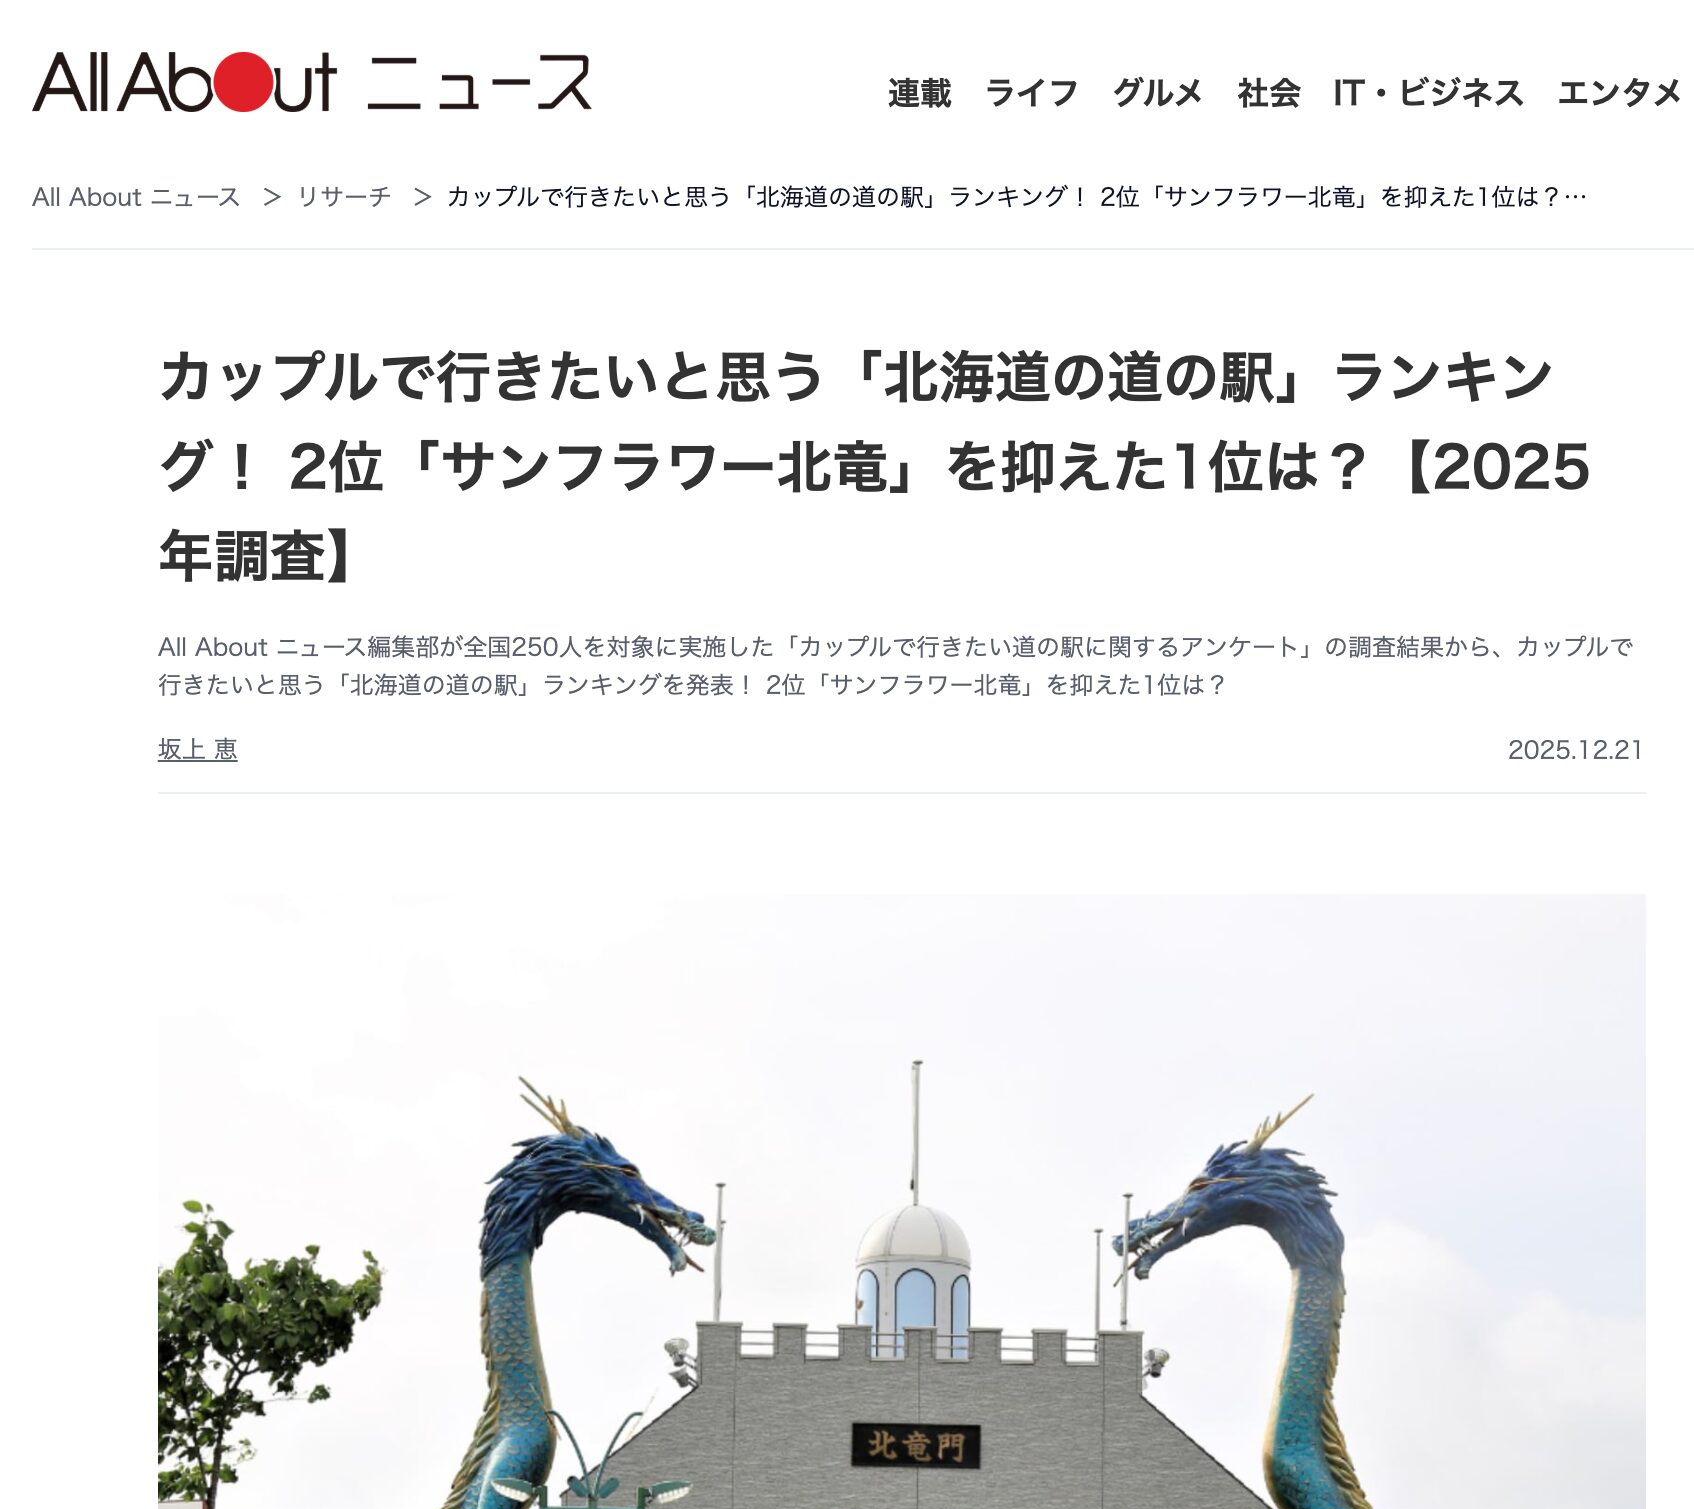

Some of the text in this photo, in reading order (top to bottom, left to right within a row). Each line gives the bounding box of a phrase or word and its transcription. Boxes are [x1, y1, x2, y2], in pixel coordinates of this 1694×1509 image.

[31, 51, 593, 113] All About ニュース
[888, 77, 952, 108] 連載
[986, 77, 1078, 108] ライフ
[1113, 77, 1202, 108] グルメ
[1237, 77, 1302, 108] 社会
[1558, 77, 1681, 108] エンタメ
[31, 184, 240, 209] All About ニュース
[300, 184, 391, 209] リサーチ
[448, 184, 1083, 209] カップルで行きたいと思う「北海道の道の駅」ランキング！
[161, 349, 1552, 404] カップルで行きたいと思う「北海道の道の駅」ランキン
[160, 437, 1590, 495] グ！ 2位「サンフラワー北竜」を抑えた1位は？【2025
[159, 527, 347, 584] 年調査】
[157, 634, 186, 659] All
[194, 634, 268, 659] About
[158, 672, 1224, 697] 行きたいと思う「北海道の道の駅」ランキングを発表！ 2位「サンフラワー北竜」を抑えた1位は？
[157, 736, 238, 761] 坂上 恵
[1508, 740, 1640, 760] 2025.12.21
[867, 1429, 967, 1463] 北竜門
